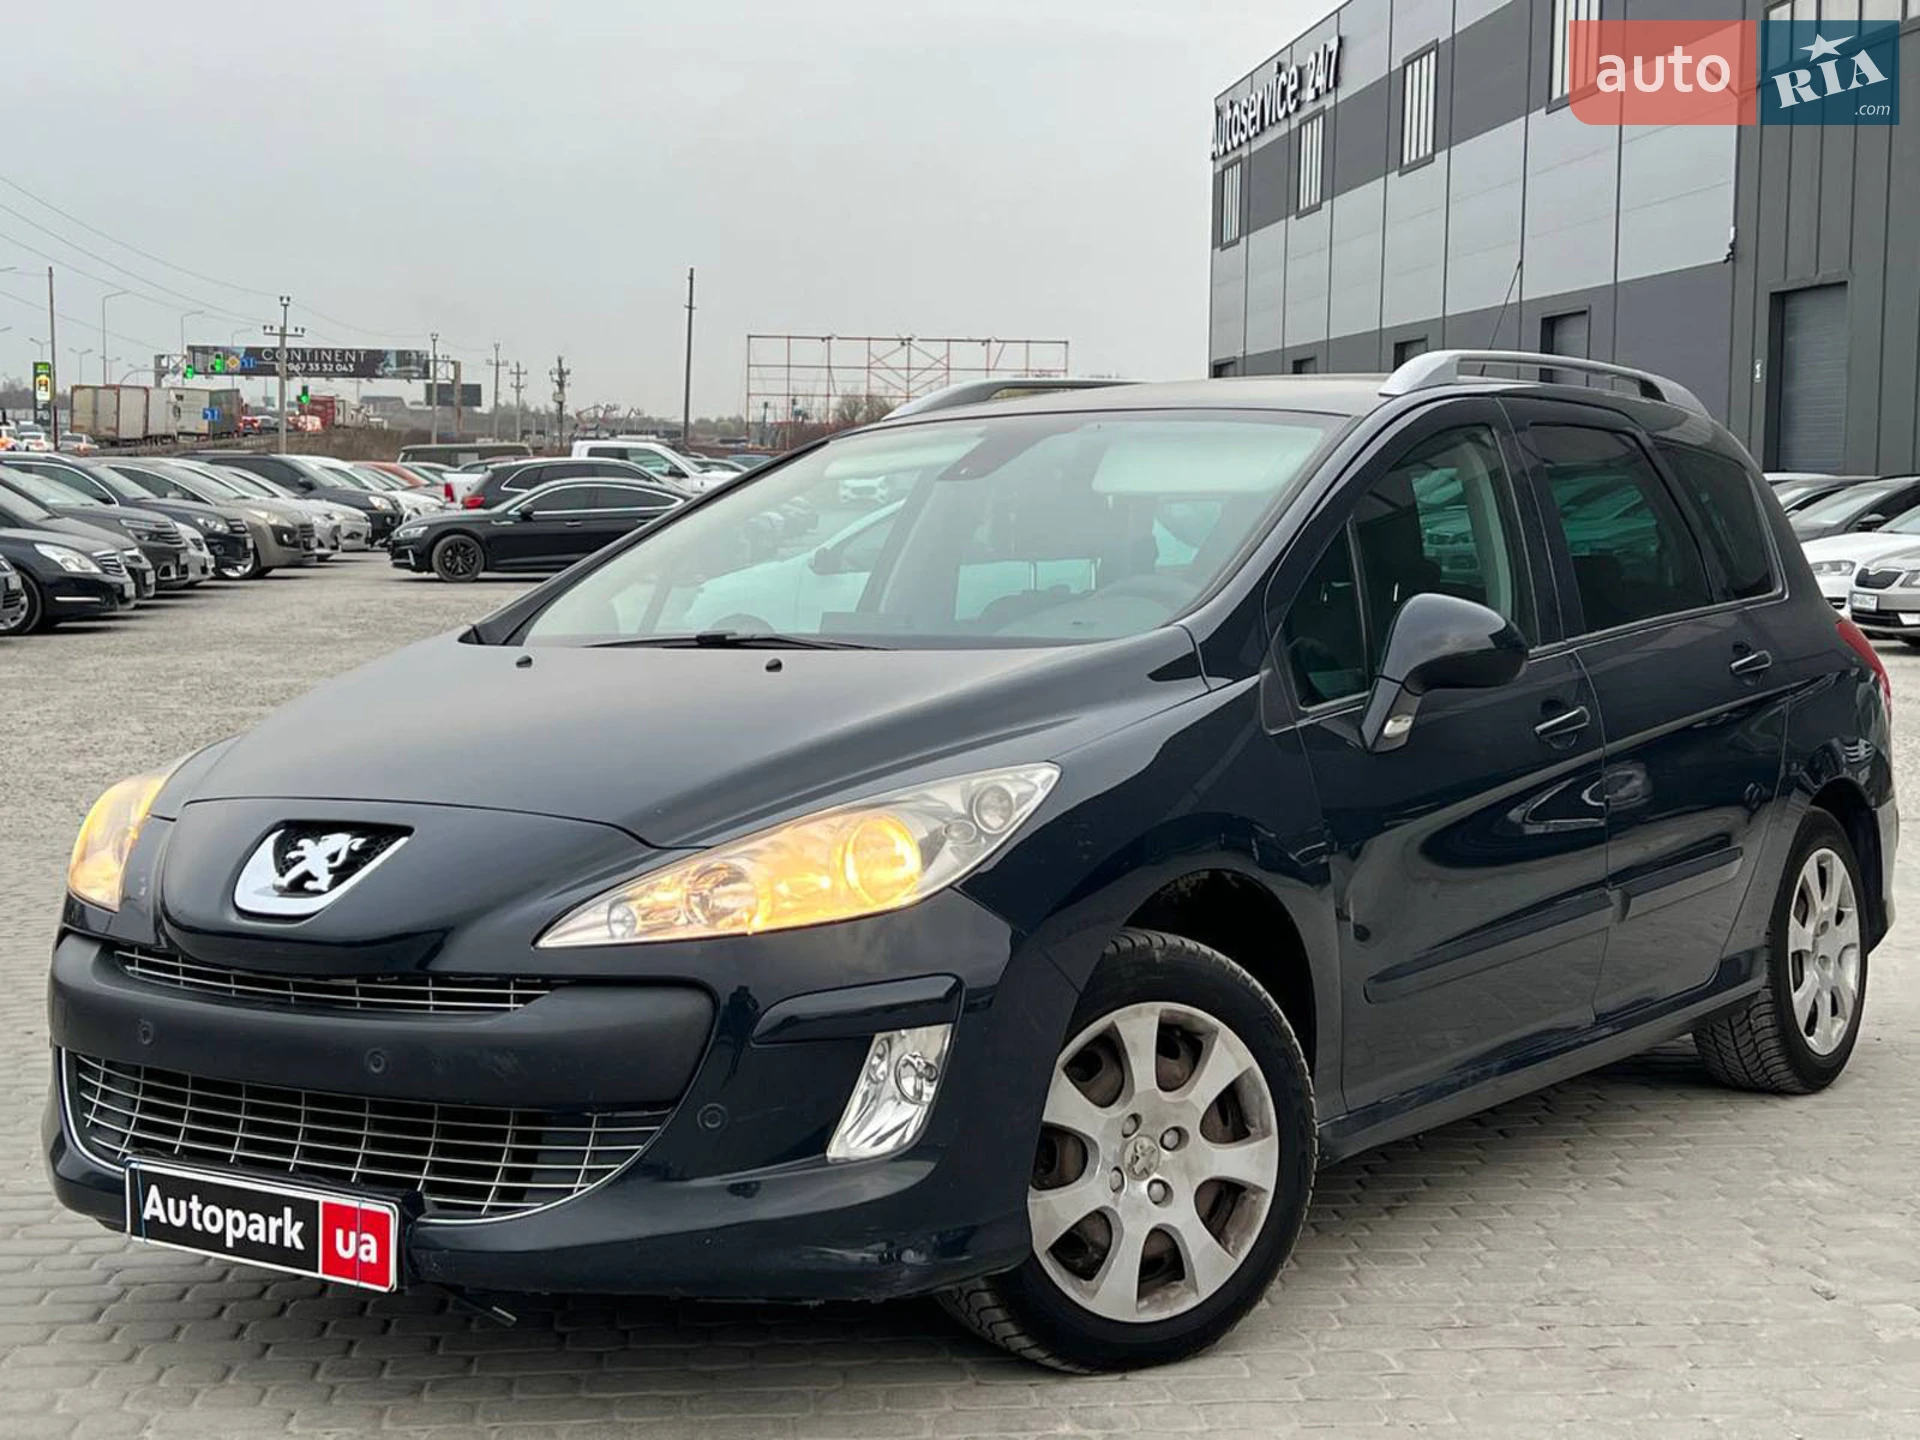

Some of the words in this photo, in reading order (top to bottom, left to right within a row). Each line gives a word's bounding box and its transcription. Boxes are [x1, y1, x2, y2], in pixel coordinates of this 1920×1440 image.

[1211, 61, 1299, 159] Autoservice
[1306, 35, 1342, 102] 24/7
[262, 348, 366, 362] CONTINENT
[308, 363, 320, 372] 33
[143, 1184, 305, 1250] Autopark
[335, 1228, 378, 1264] ua
